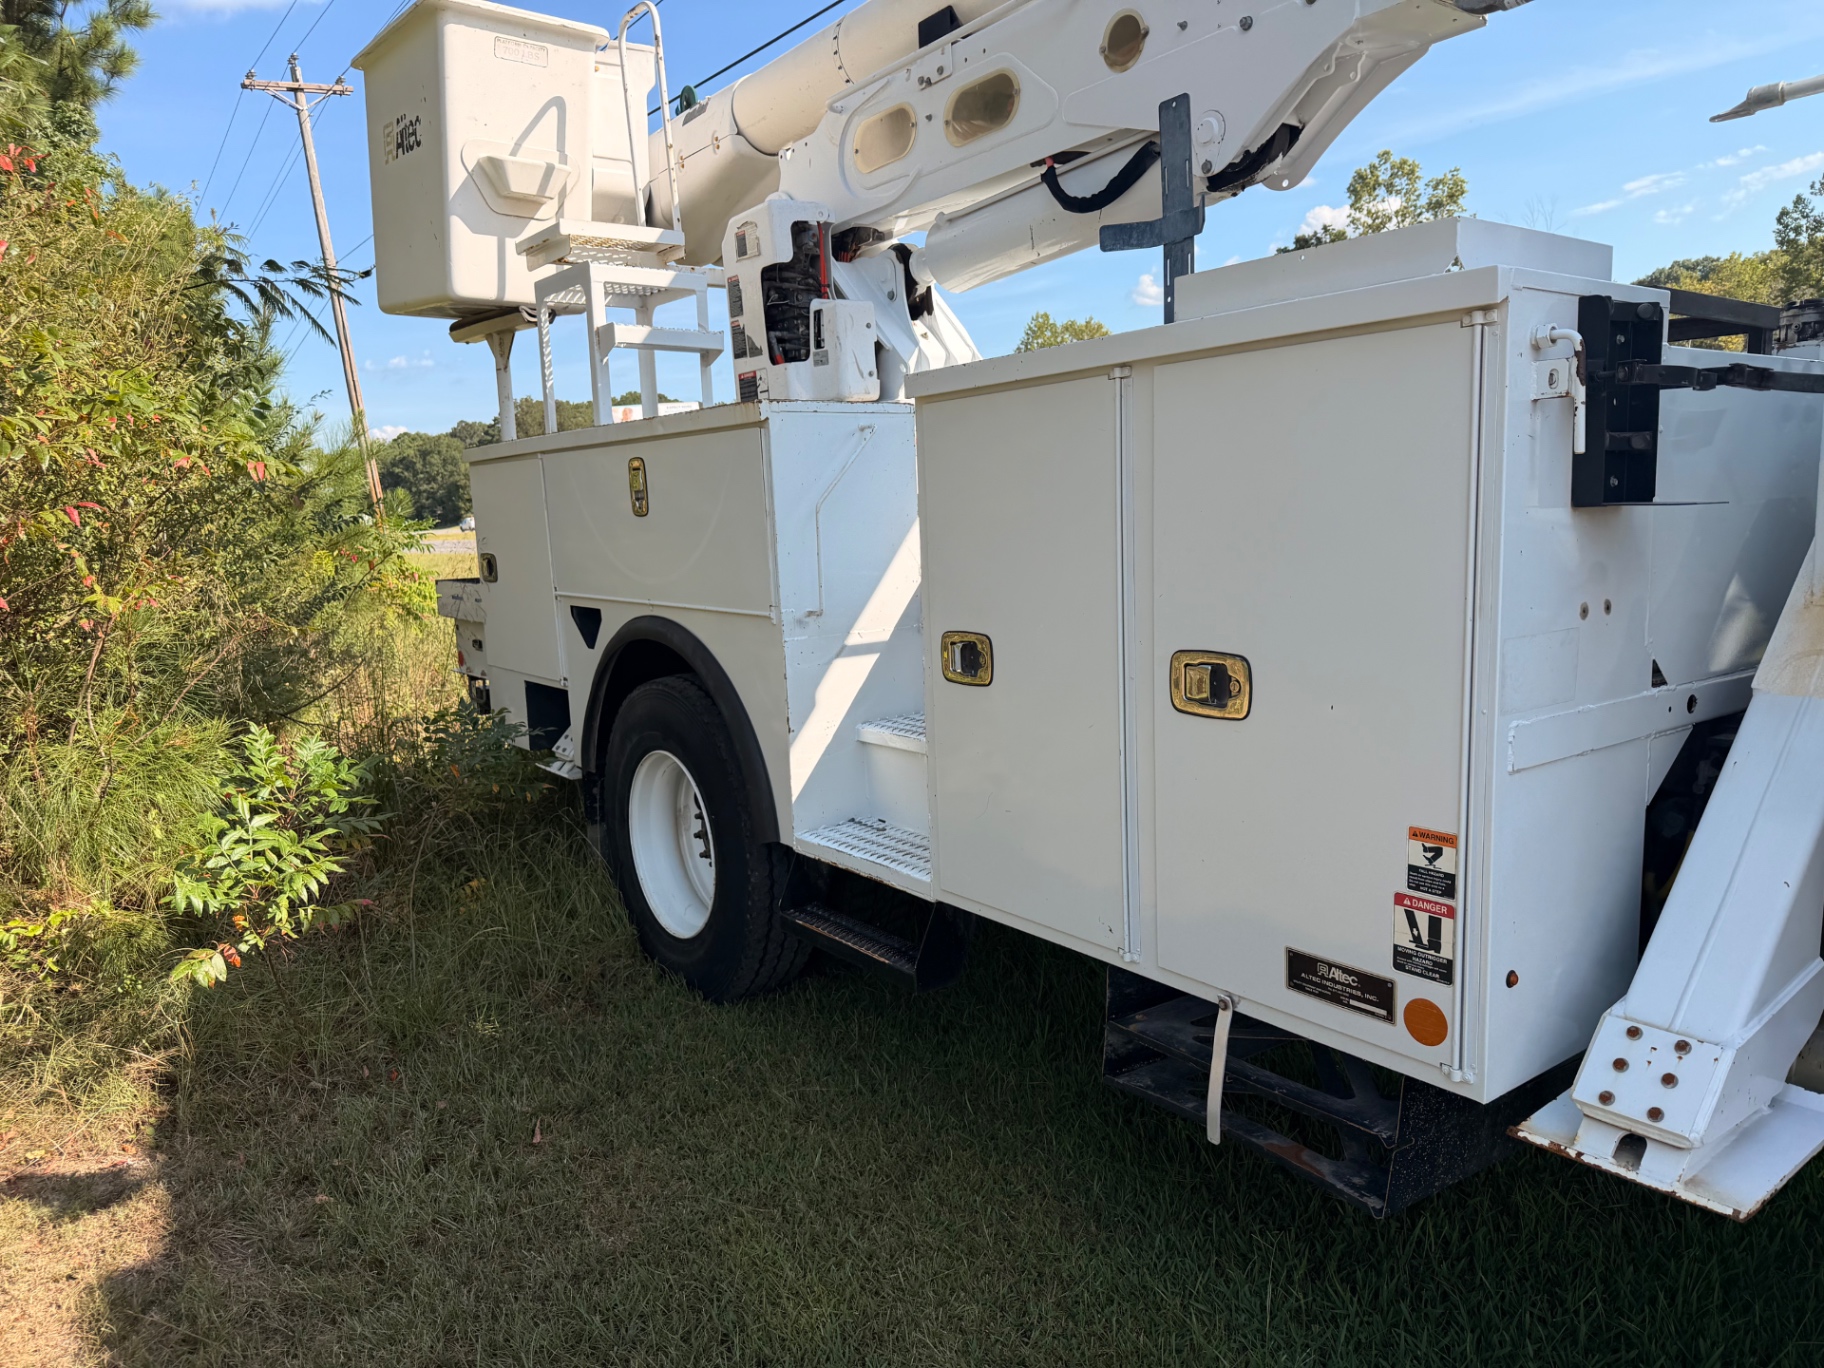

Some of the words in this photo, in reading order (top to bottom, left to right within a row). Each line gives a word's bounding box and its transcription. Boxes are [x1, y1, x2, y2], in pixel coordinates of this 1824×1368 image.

[1419, 831, 1454, 845] WARNING
[1412, 899, 1448, 915] DANGER
[1397, 946, 1417, 956] MOVING
[1417, 951, 1448, 964] OUTRIGGER
[1412, 956, 1433, 966] HAZARD
[1329, 966, 1358, 986] Altec
[1405, 965, 1422, 974] STAND
[1422, 969, 1440, 979] CLEAR
[1301, 973, 1321, 983] ALTEC
[1321, 979, 1364, 998] INDUSTRIES,
[1364, 993, 1379, 1002] INC.
